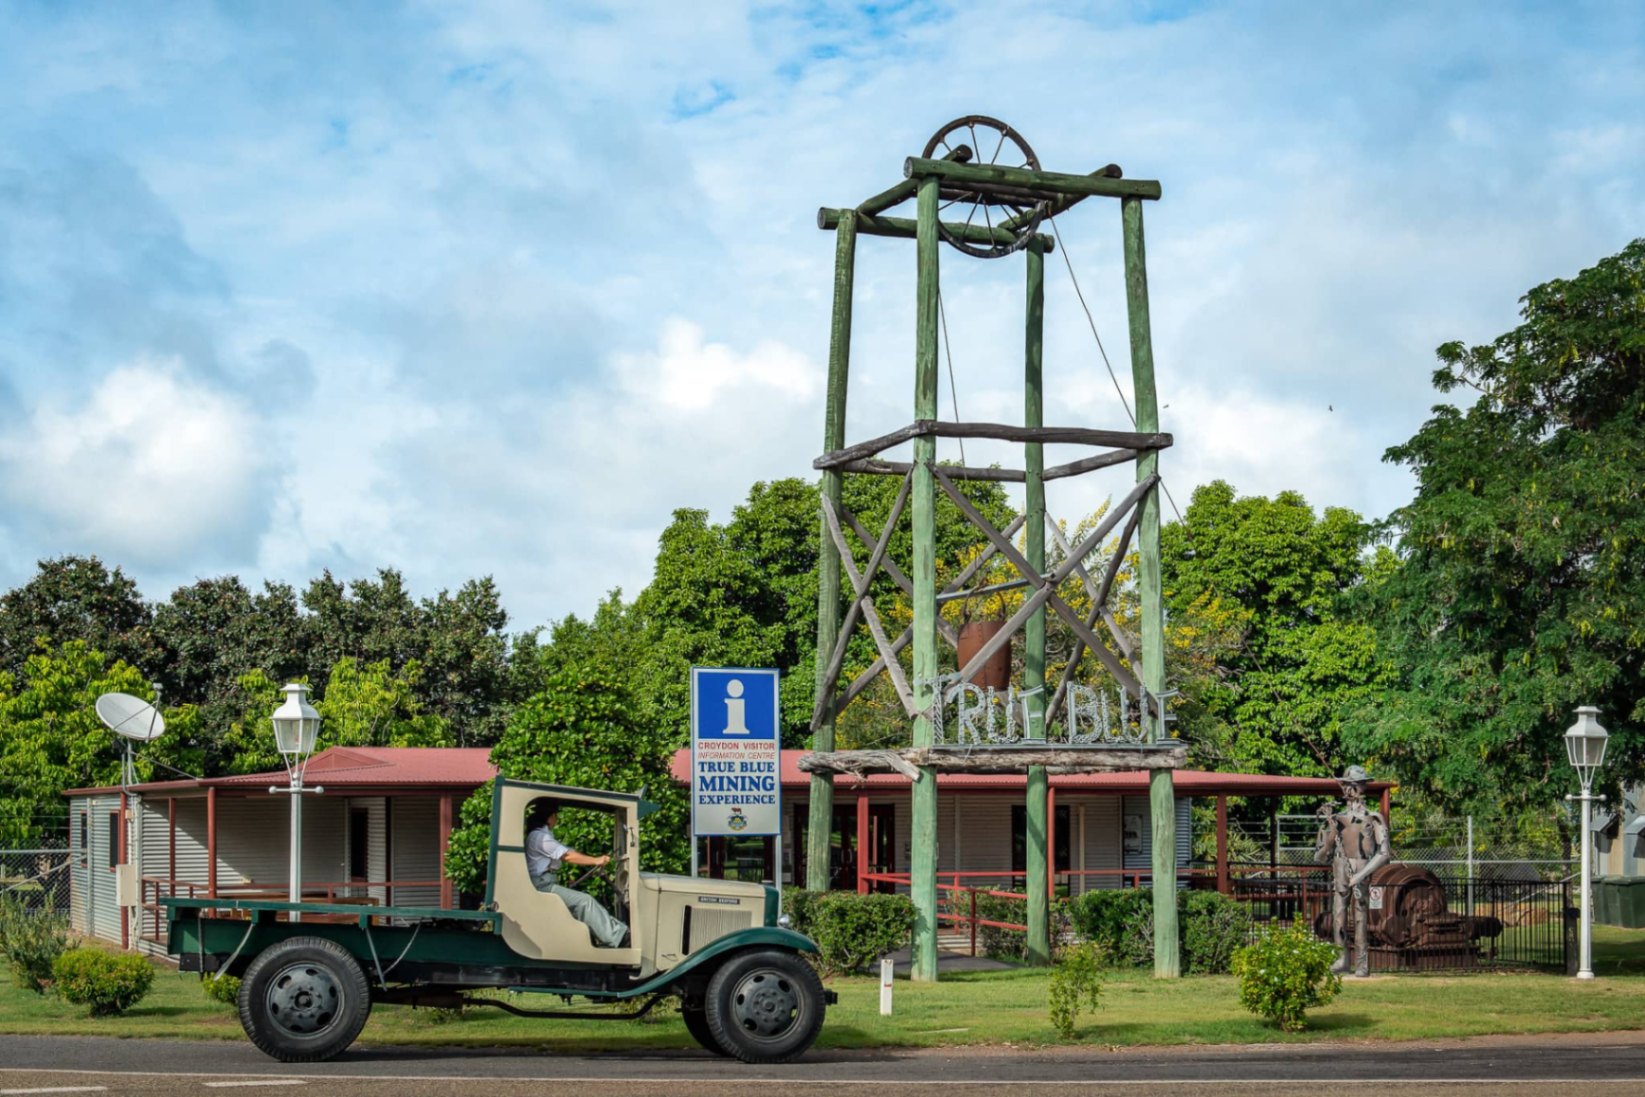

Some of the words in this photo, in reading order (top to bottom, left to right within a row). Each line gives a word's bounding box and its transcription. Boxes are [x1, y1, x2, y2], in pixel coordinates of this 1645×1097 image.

[914, 676, 1047, 744] TRUE
[1066, 681, 1179, 744] BLUE
[698, 742, 739, 750] CROYDON
[743, 742, 775, 750] VISITOR
[698, 761, 736, 772] TRUE
[740, 761, 775, 772] BLUE
[699, 775, 775, 792] MINING
[699, 794, 776, 805] EXPERIENCE
